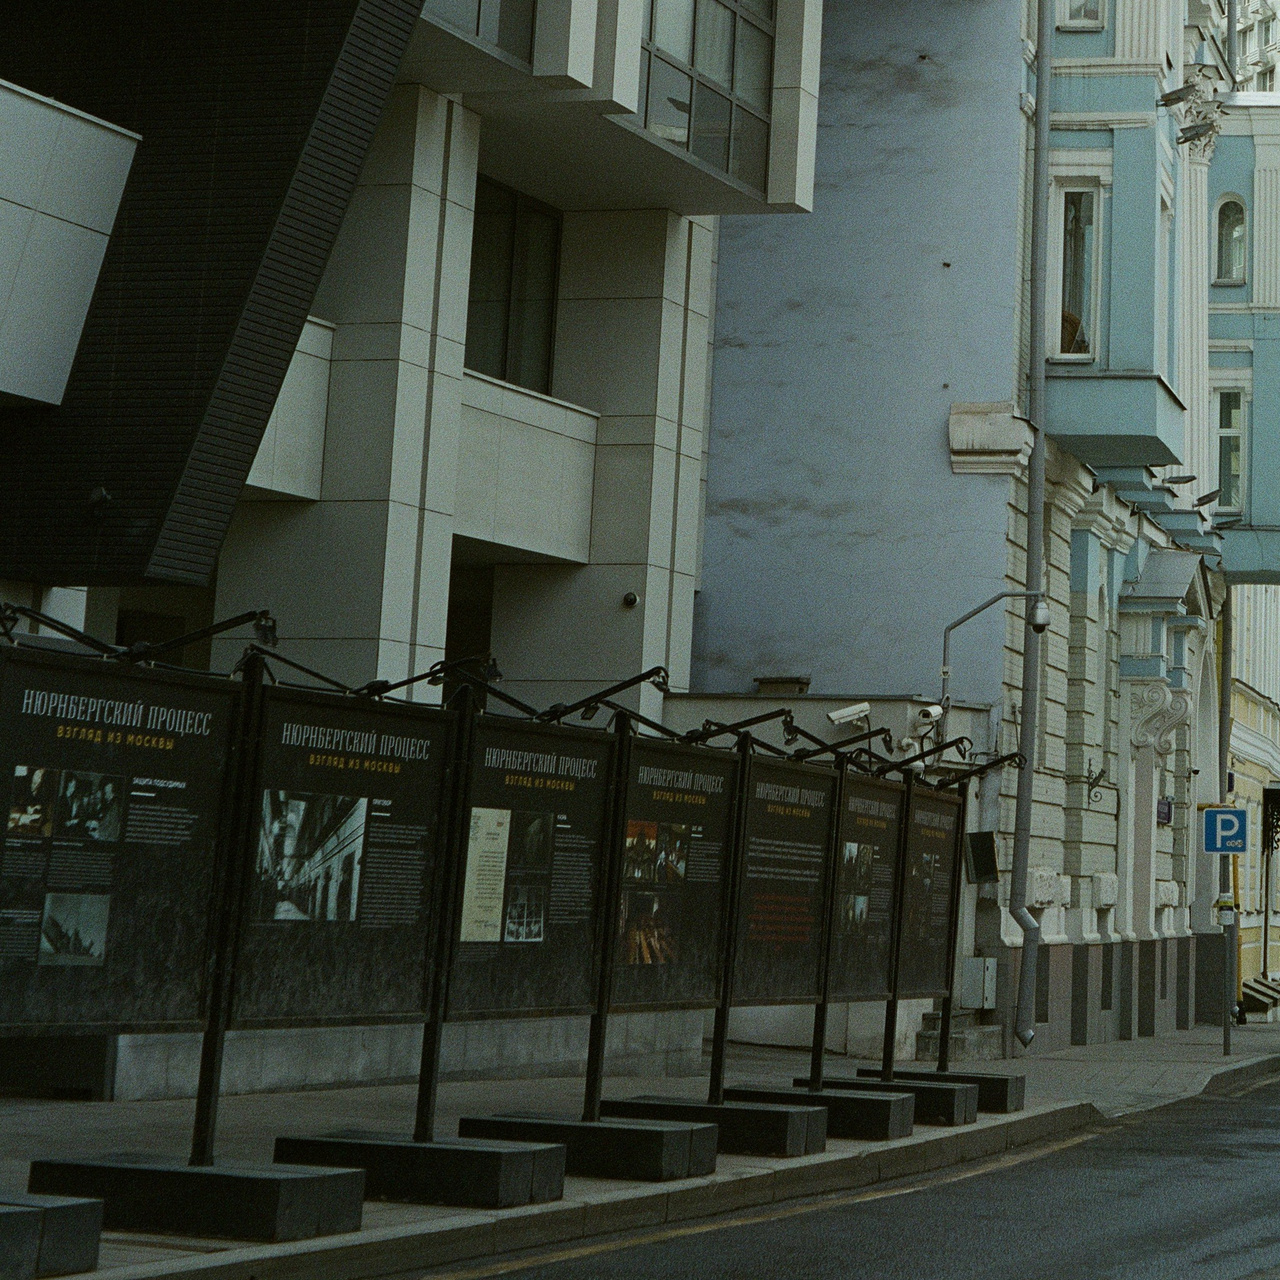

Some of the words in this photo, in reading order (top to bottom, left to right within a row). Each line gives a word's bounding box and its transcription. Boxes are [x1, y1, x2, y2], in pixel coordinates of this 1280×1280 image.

[21, 689, 144, 728] НЮРНБЕРГСКИЙ
[147, 705, 212, 737] ПРОЦЕСС
[56, 725, 103, 744] ВЗГЛЯД
[107, 730, 122, 744] ИЗ
[126, 732, 175, 750] МОСКВЫ
[281, 722, 377, 754] НЮРНБЕРГСКИЙ
[379, 734, 431, 762] ПРОЦЕСС
[309, 754, 345, 770] ВЗГЛЯД
[348, 758, 360, 770] ИЗ
[363, 759, 401, 774] МОСКВЫ
[484, 747, 557, 775] НЮРНБЕРГСКИЙ
[558, 756, 598, 780] ПРОЦЕСС
[638, 766, 693, 790] НЮРНБЕРГСКИЙ
[693, 773, 725, 795] ПРОЦЕСС
[1216, 813, 1239, 848] P
